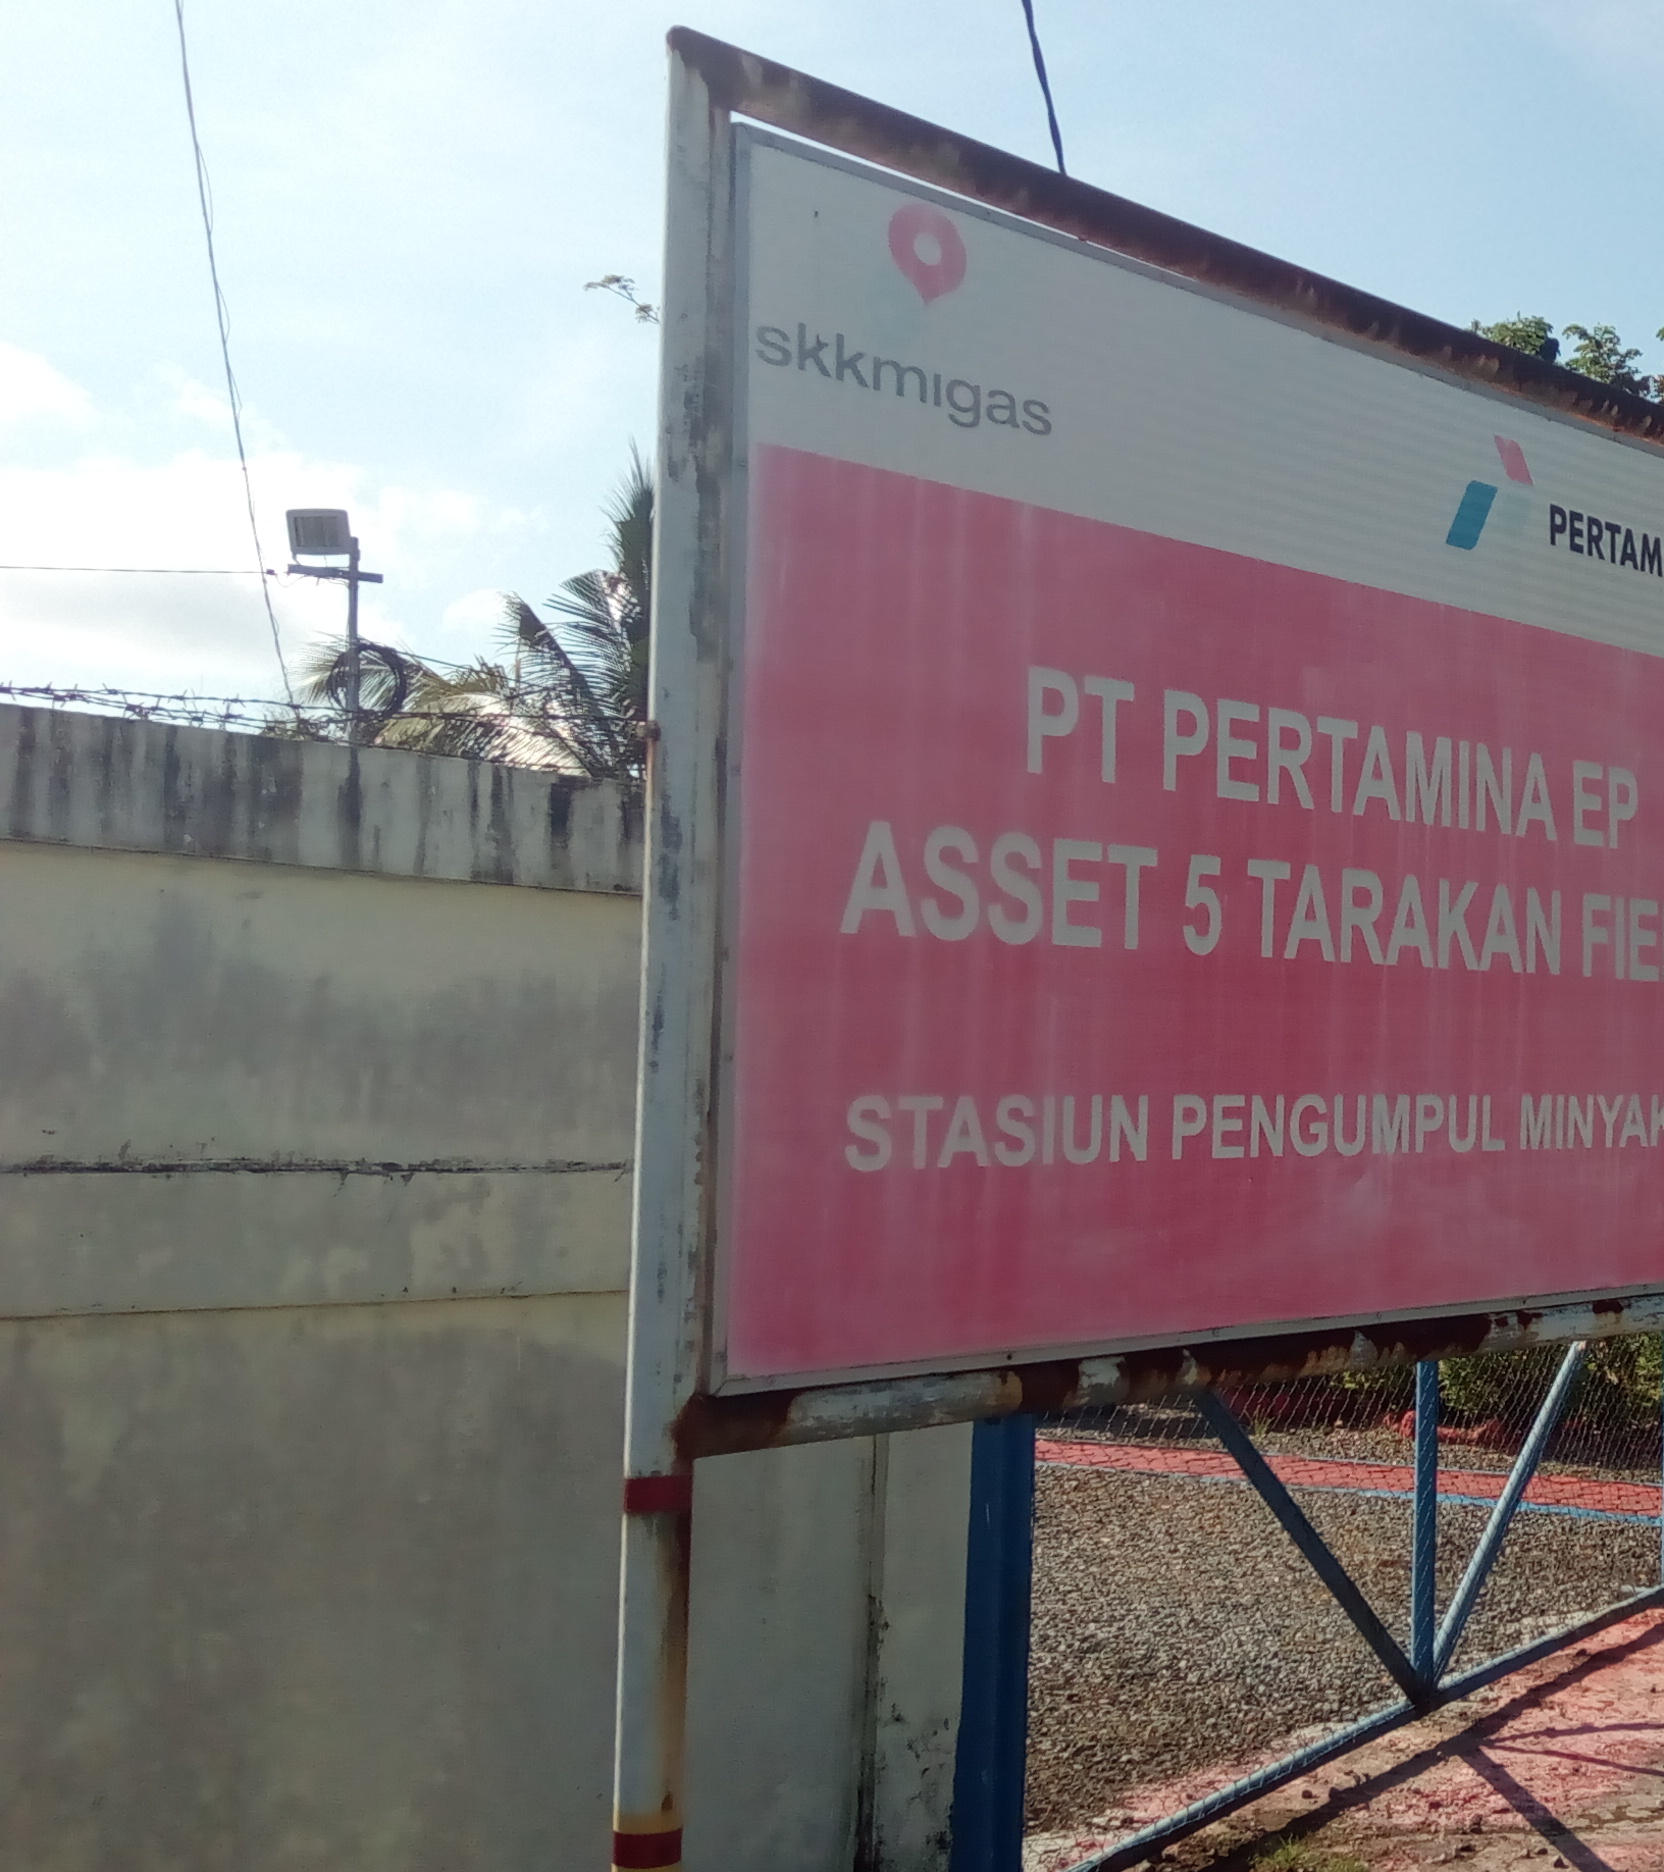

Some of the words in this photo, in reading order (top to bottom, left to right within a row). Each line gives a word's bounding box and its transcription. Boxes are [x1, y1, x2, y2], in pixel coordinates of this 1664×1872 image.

[755, 322, 1052, 435] skkmigas
[1027, 665, 1134, 784] PT
[1163, 688, 1558, 842] PERTAMINA
[1572, 760, 1639, 849] EP
[840, 820, 1158, 949] ASSET
[1182, 854, 1222, 955] 5
[1247, 858, 1562, 975] TARAKAN
[845, 1094, 1148, 1172] STASIUN
[1172, 1093, 1505, 1159] PENGUMPUL
